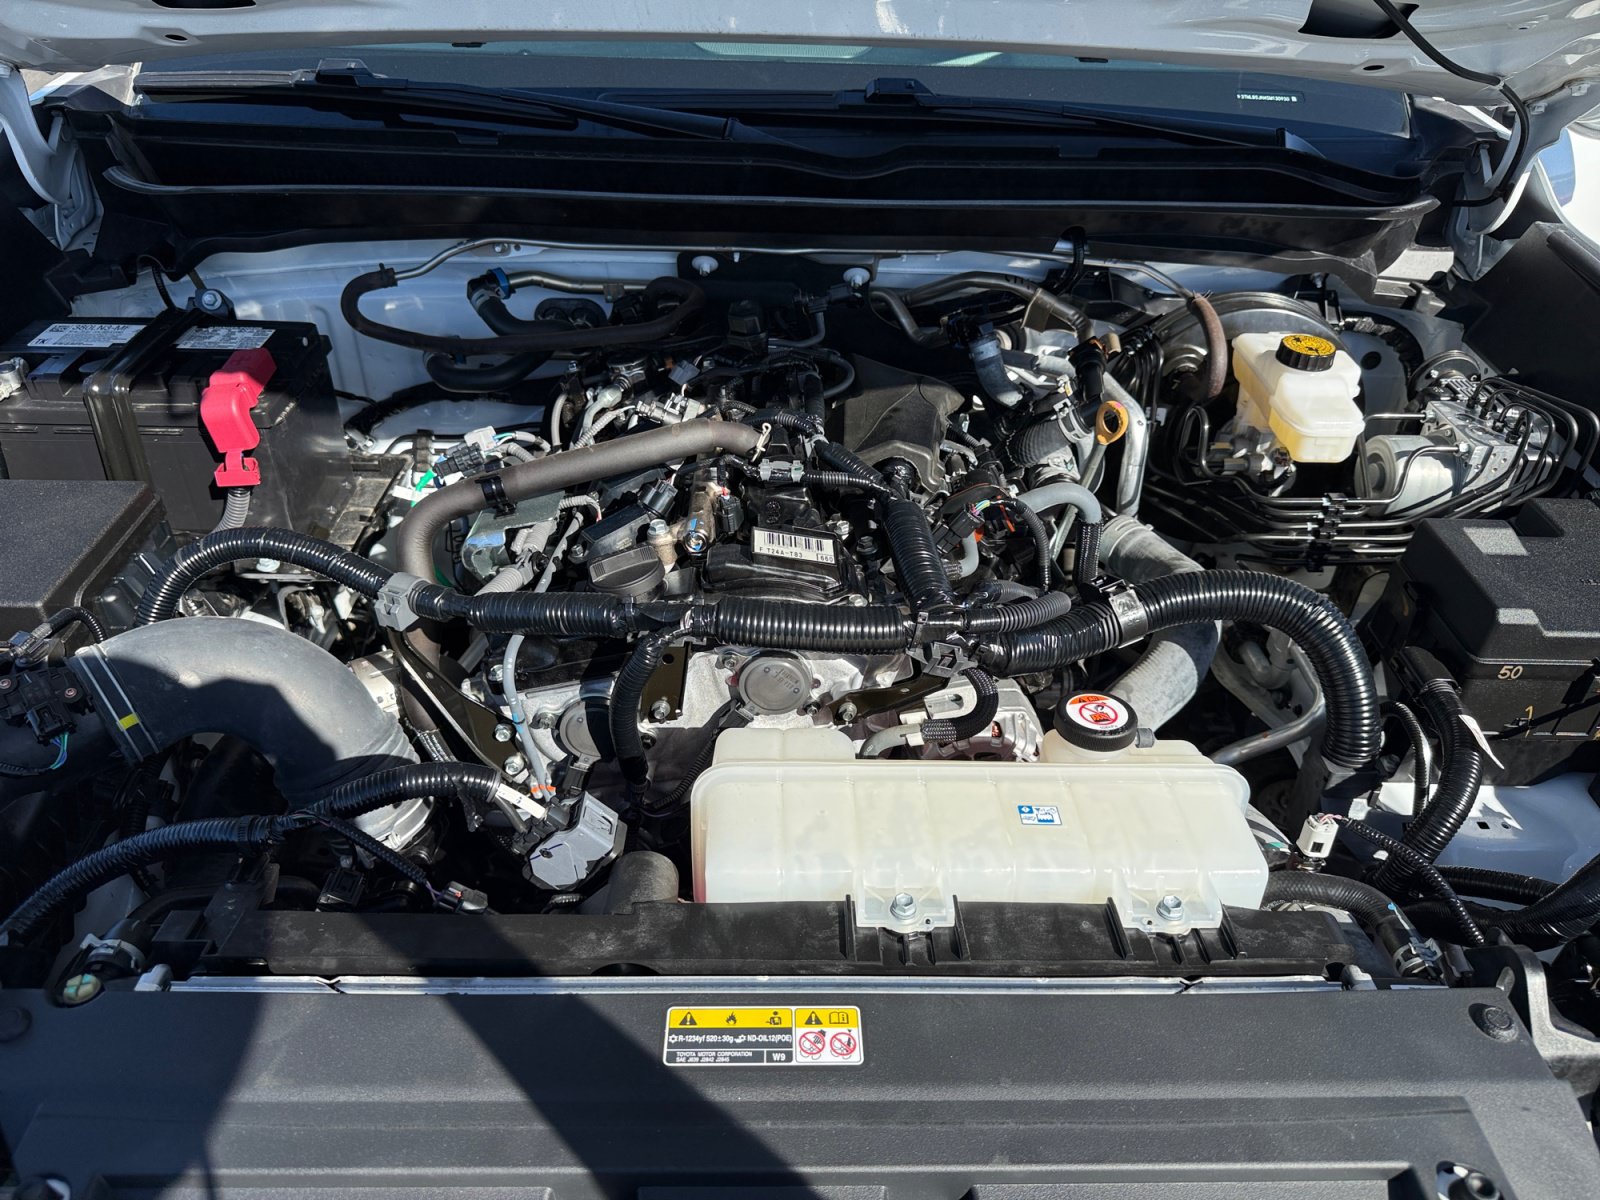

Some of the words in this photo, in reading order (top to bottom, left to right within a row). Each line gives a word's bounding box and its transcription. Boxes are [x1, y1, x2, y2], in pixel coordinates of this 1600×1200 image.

[1497, 665, 1523, 680] 50
[678, 1034, 706, 1045] R-1234yf
[747, 1034, 792, 1044] ND-OIL12(POE)
[772, 1052, 786, 1062] W9
